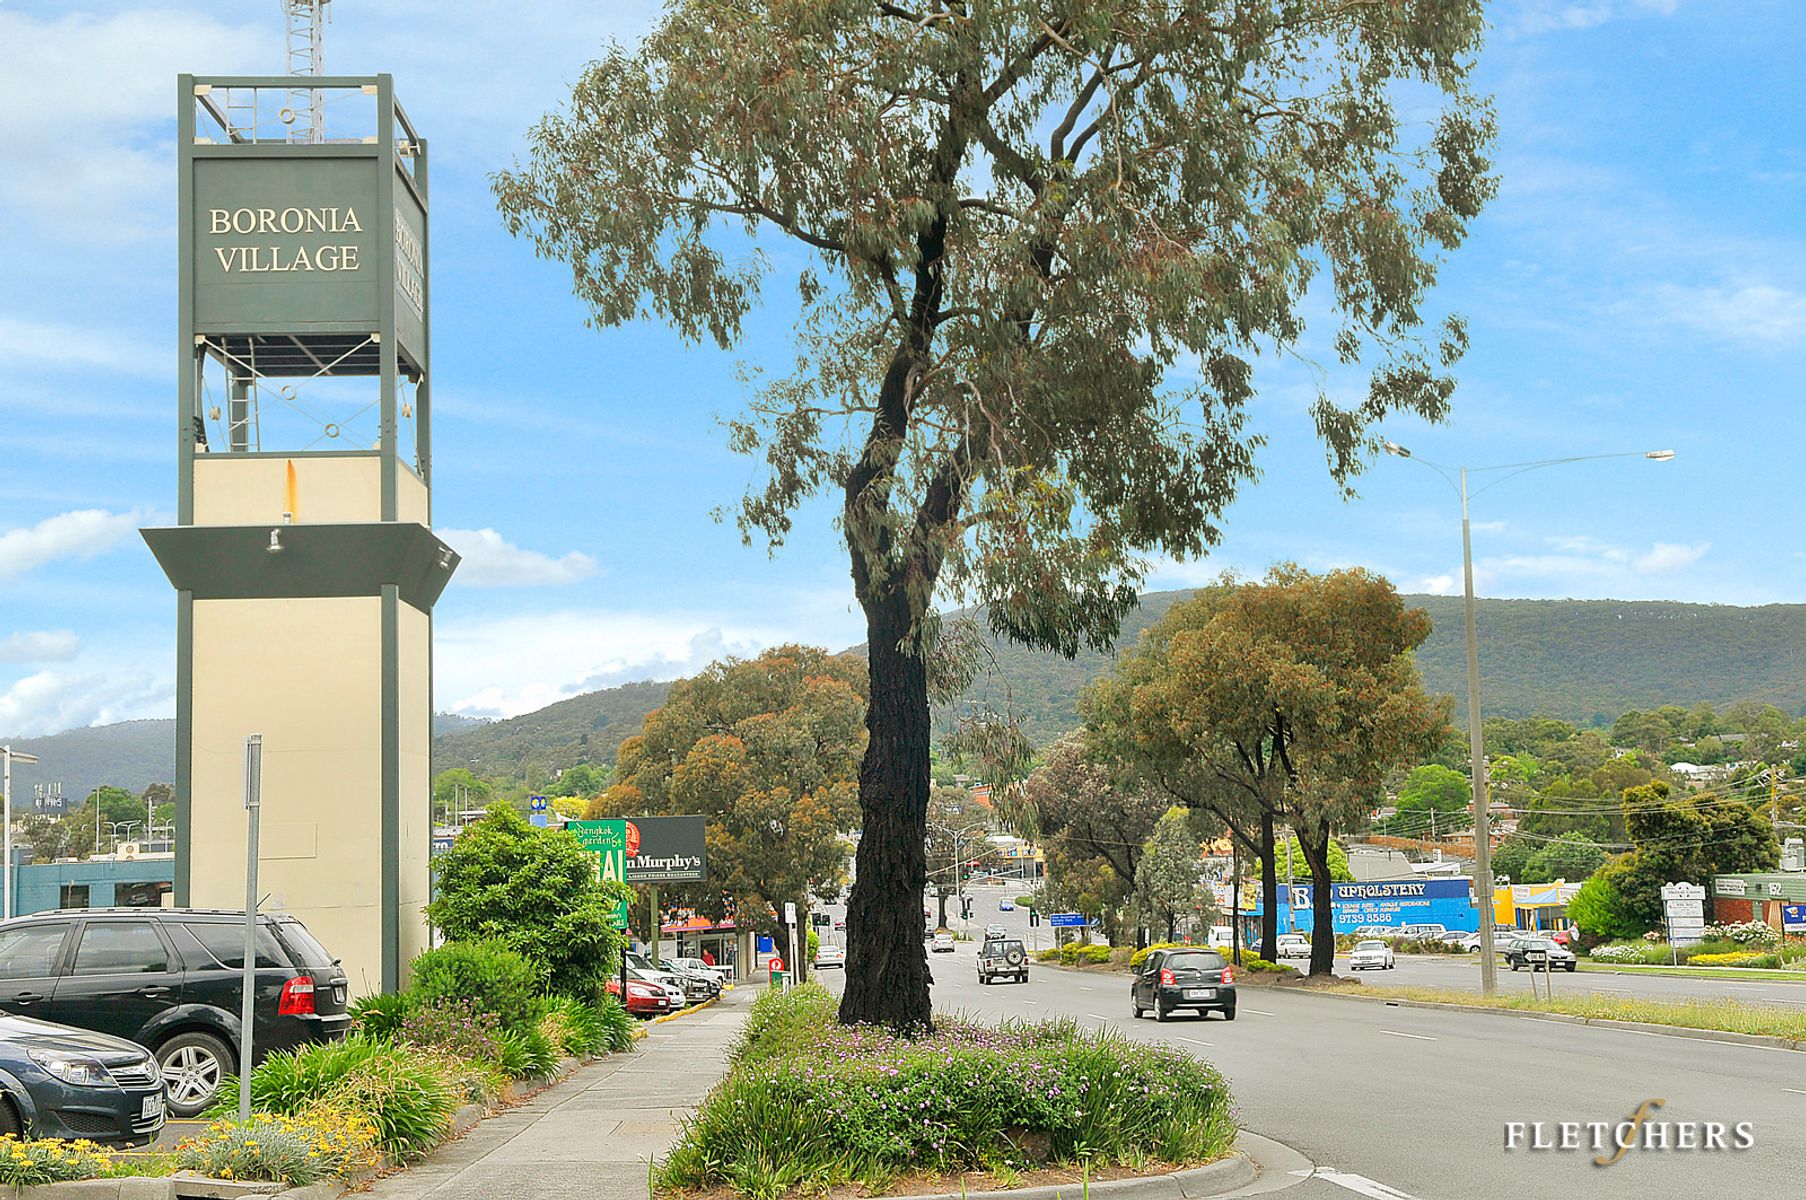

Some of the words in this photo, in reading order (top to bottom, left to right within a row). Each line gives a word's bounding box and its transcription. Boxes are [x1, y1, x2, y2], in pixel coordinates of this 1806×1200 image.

[209, 208, 363, 234] BORONIA
[214, 246, 360, 273] VILLAGE
[636, 854, 701, 871] Murphy's
